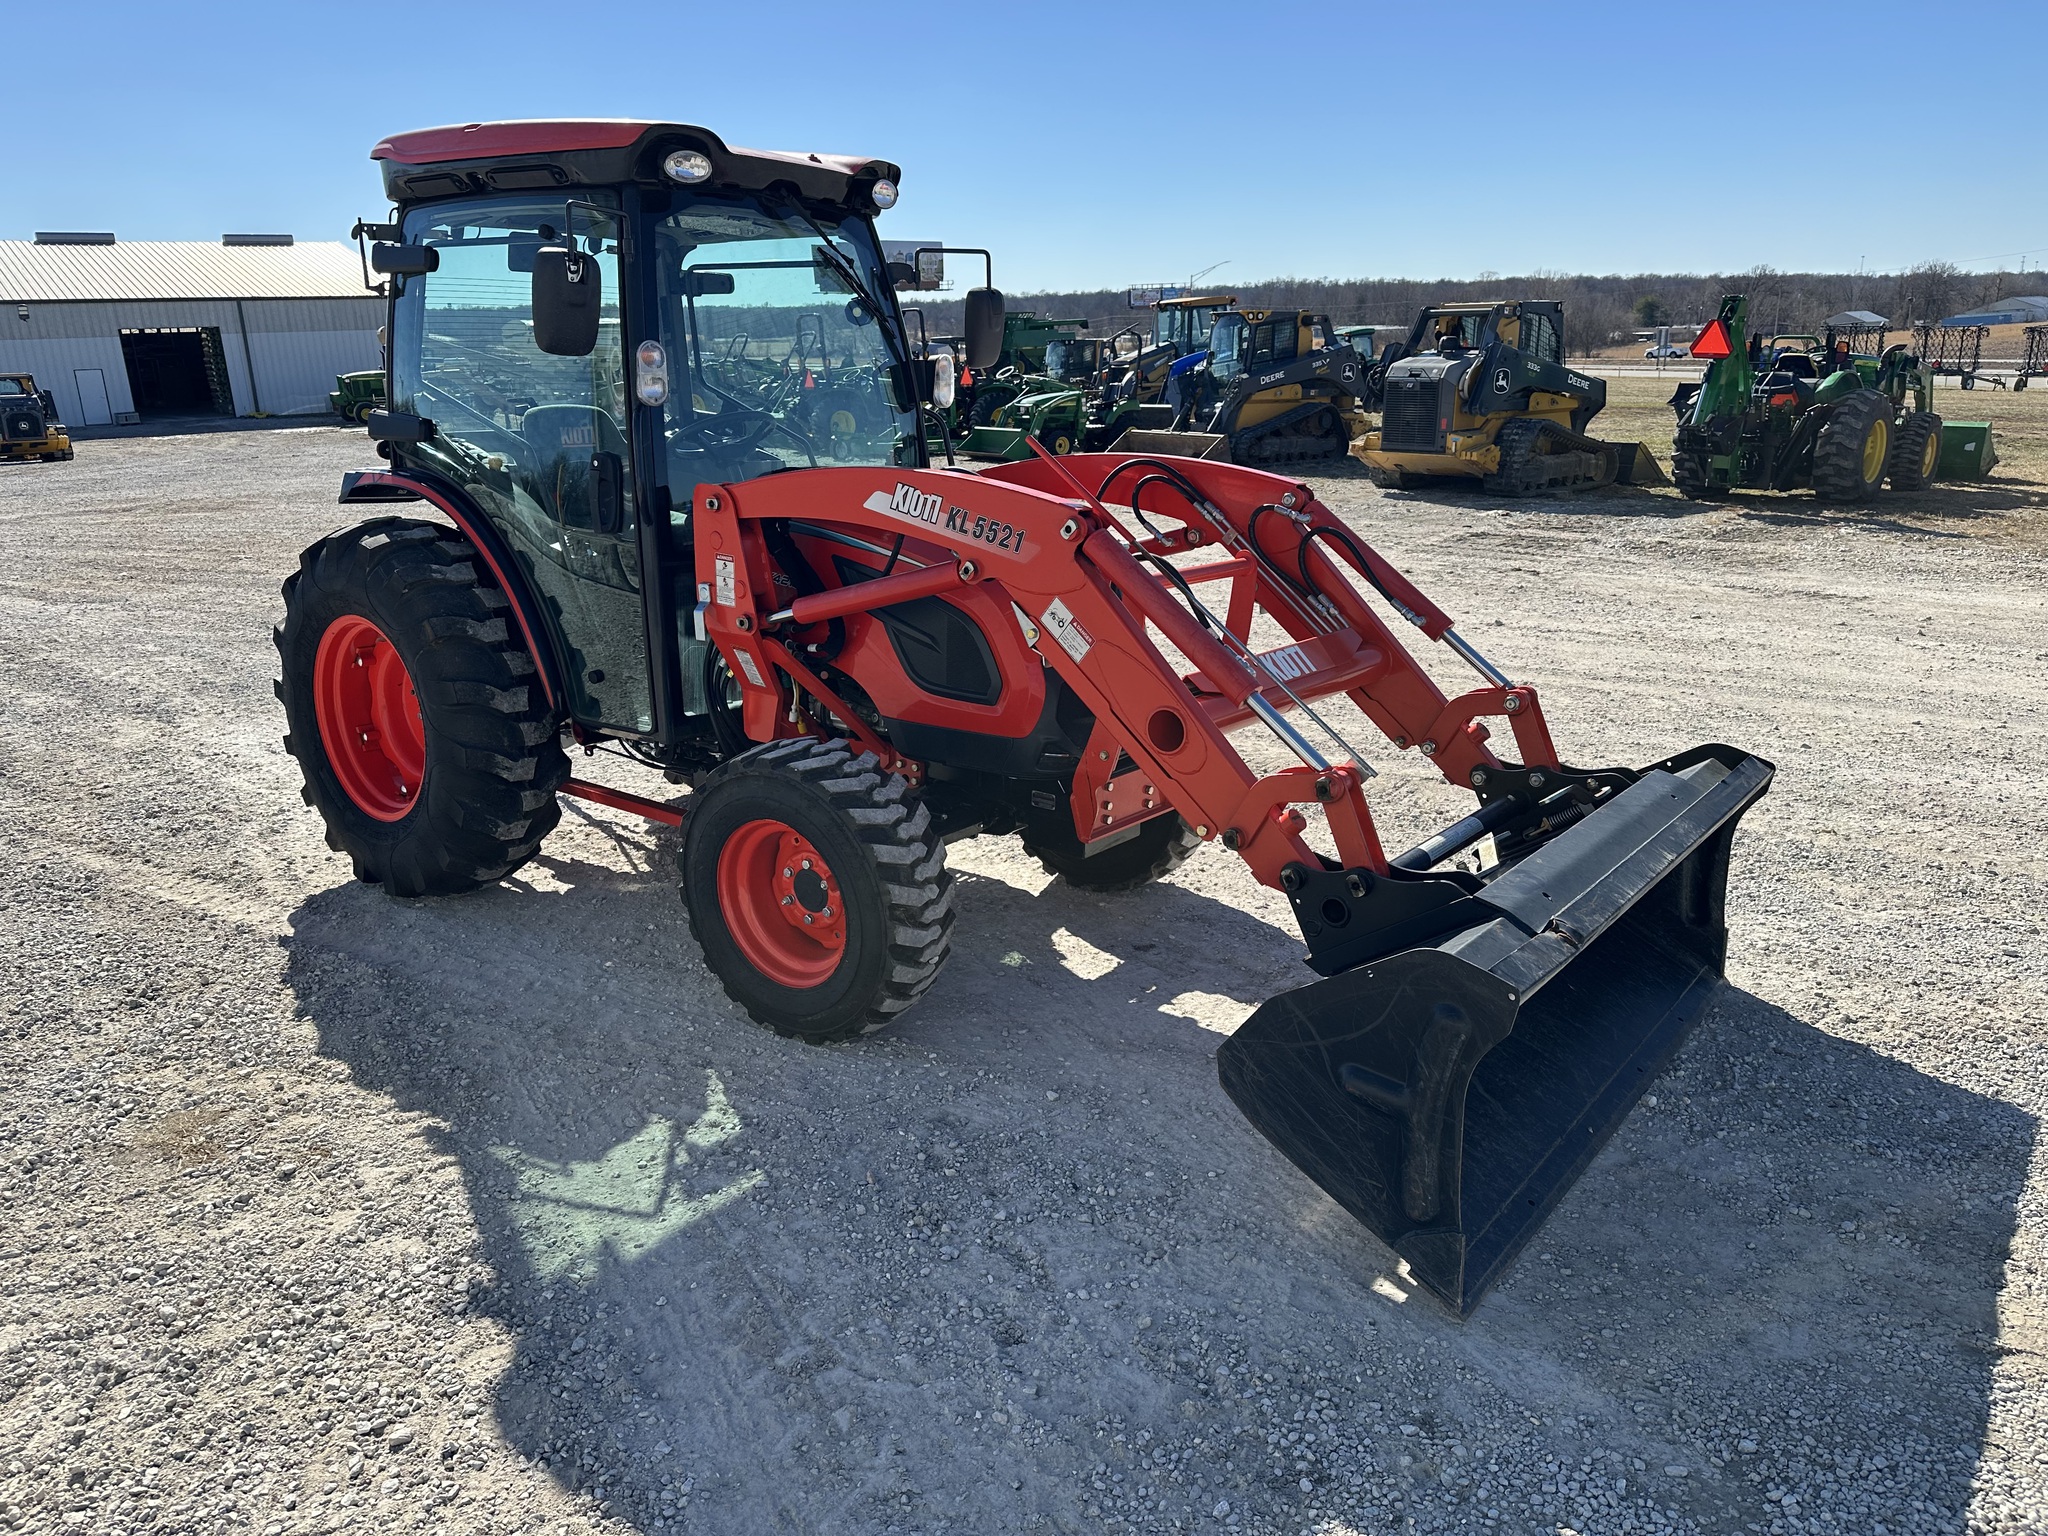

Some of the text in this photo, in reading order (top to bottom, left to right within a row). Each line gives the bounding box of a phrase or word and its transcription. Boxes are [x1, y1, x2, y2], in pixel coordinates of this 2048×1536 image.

[1260, 370, 1285, 384] DEERE
[1567, 373, 1590, 390] DEERE
[890, 482, 943, 524] KIOTI
[1075, 624, 1093, 644] DANGER
[1258, 645, 1318, 683] KIOTI
